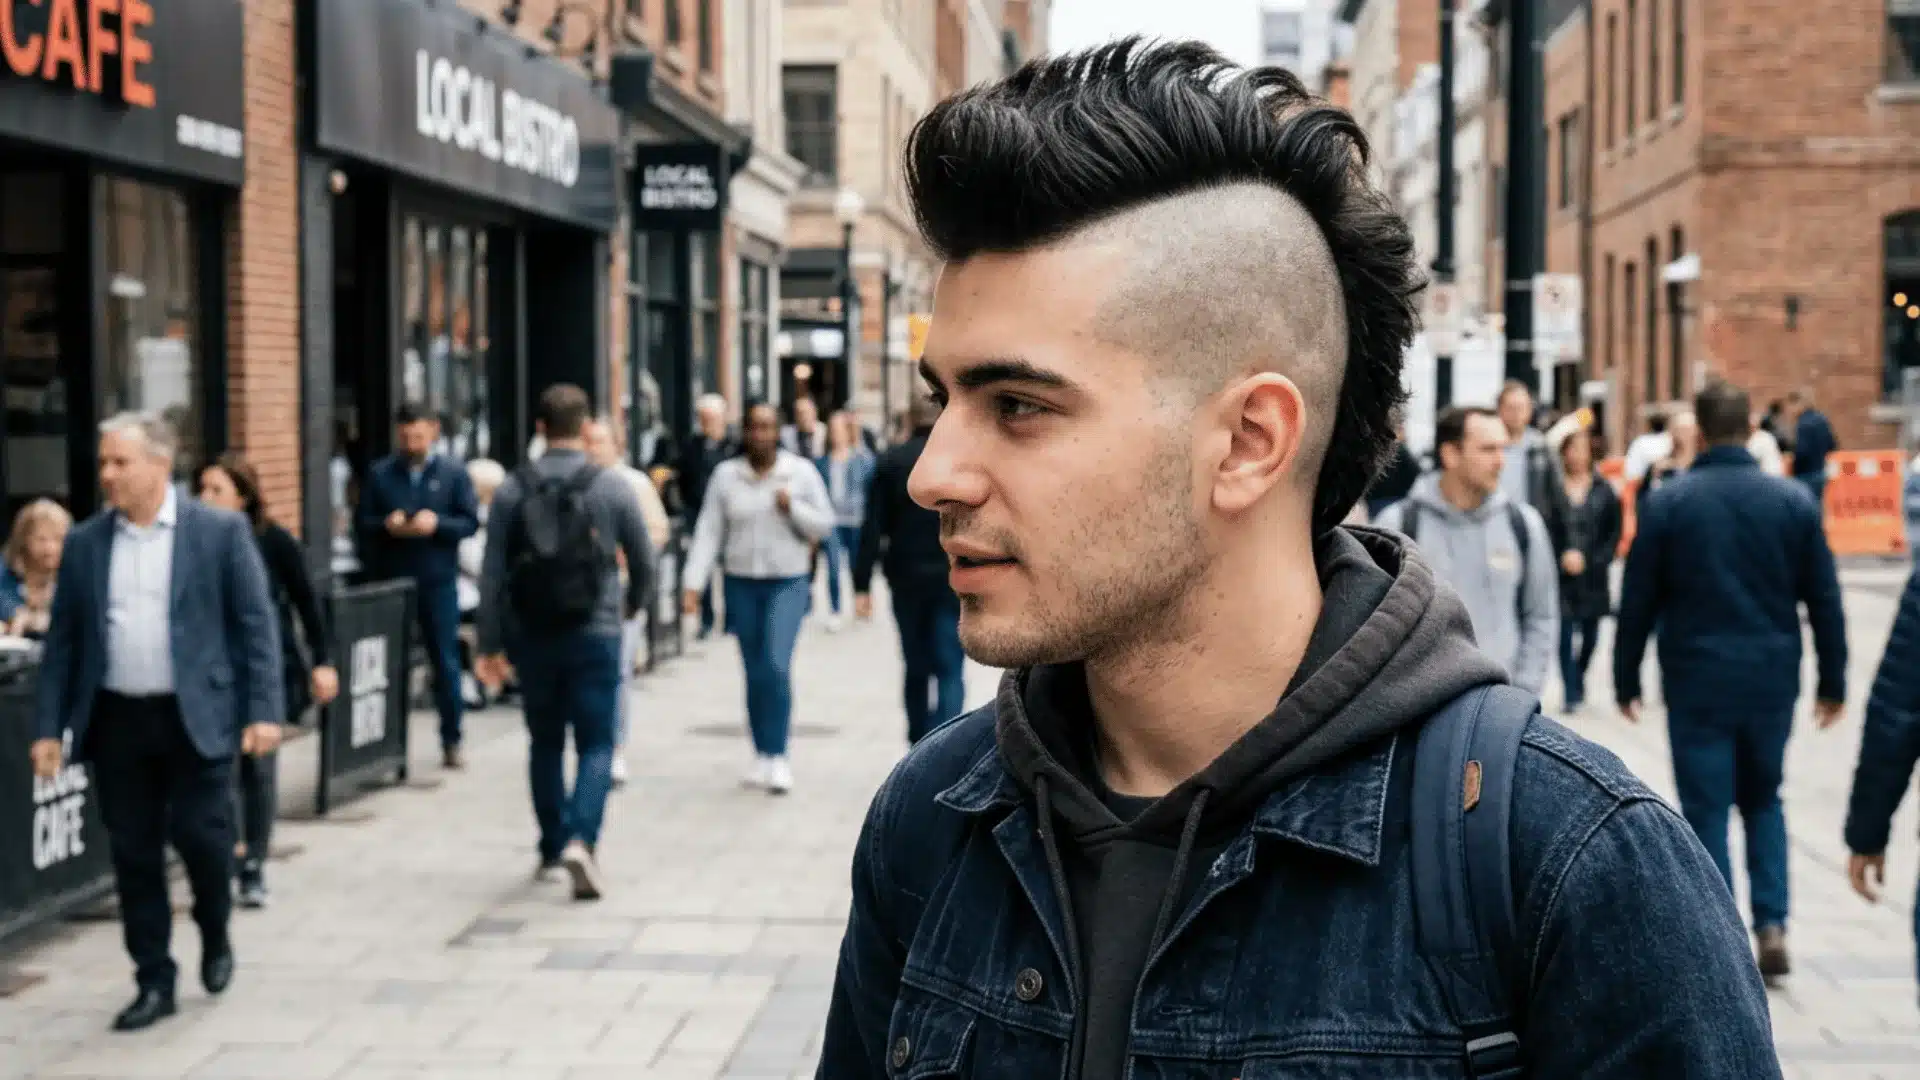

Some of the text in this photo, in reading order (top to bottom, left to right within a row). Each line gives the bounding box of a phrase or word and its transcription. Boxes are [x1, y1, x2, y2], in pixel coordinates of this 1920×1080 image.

[0, 0, 156, 108] CAFE
[416, 48, 580, 188] LOCAL BISTRO
[640, 187, 718, 209] BISTRO
[643, 163, 714, 186] LOCAL
[33, 793, 86, 870] CAFE
